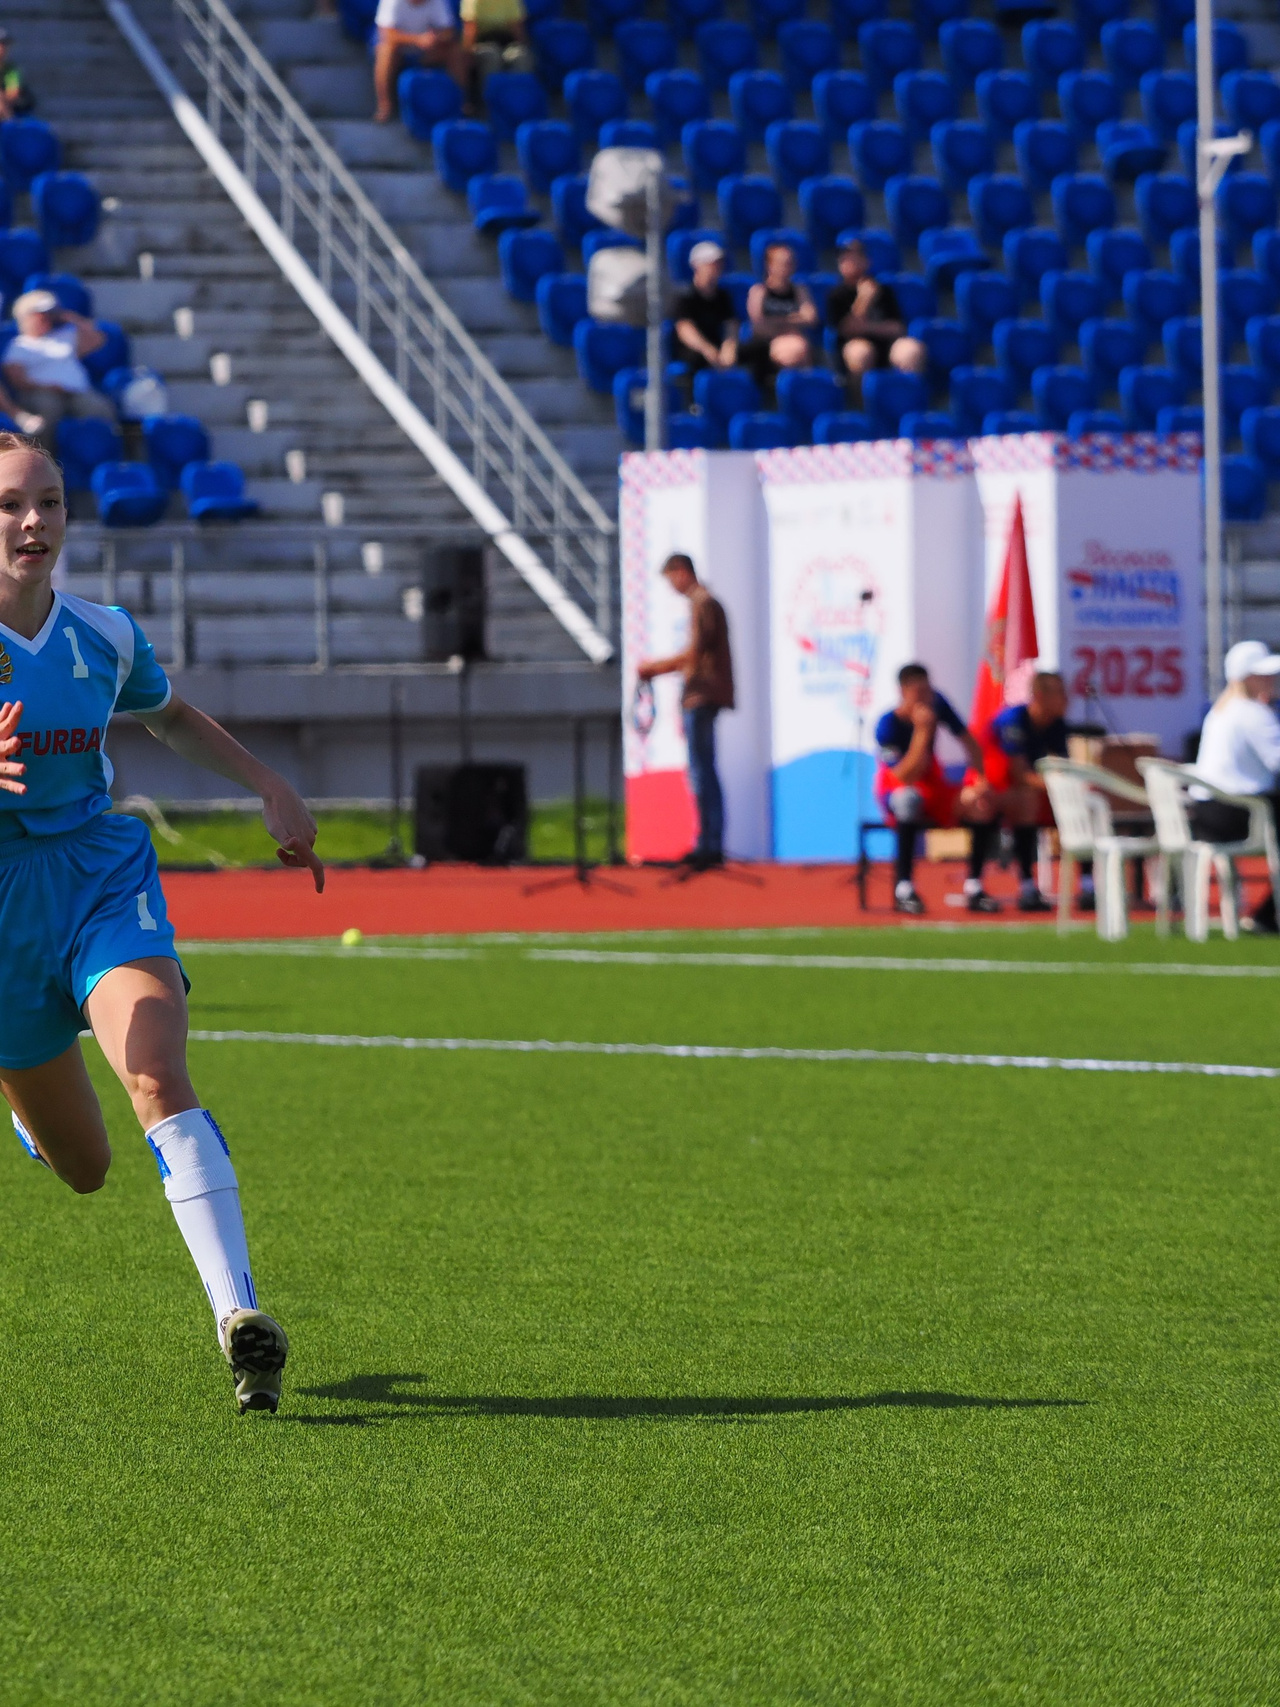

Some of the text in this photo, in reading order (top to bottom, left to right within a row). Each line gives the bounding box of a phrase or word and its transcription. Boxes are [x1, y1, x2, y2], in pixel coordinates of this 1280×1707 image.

[62, 626, 89, 679] 1
[1073, 645, 1184, 696] 2025
[14, 726, 106, 757] FURBA
[136, 890, 157, 931] 1
